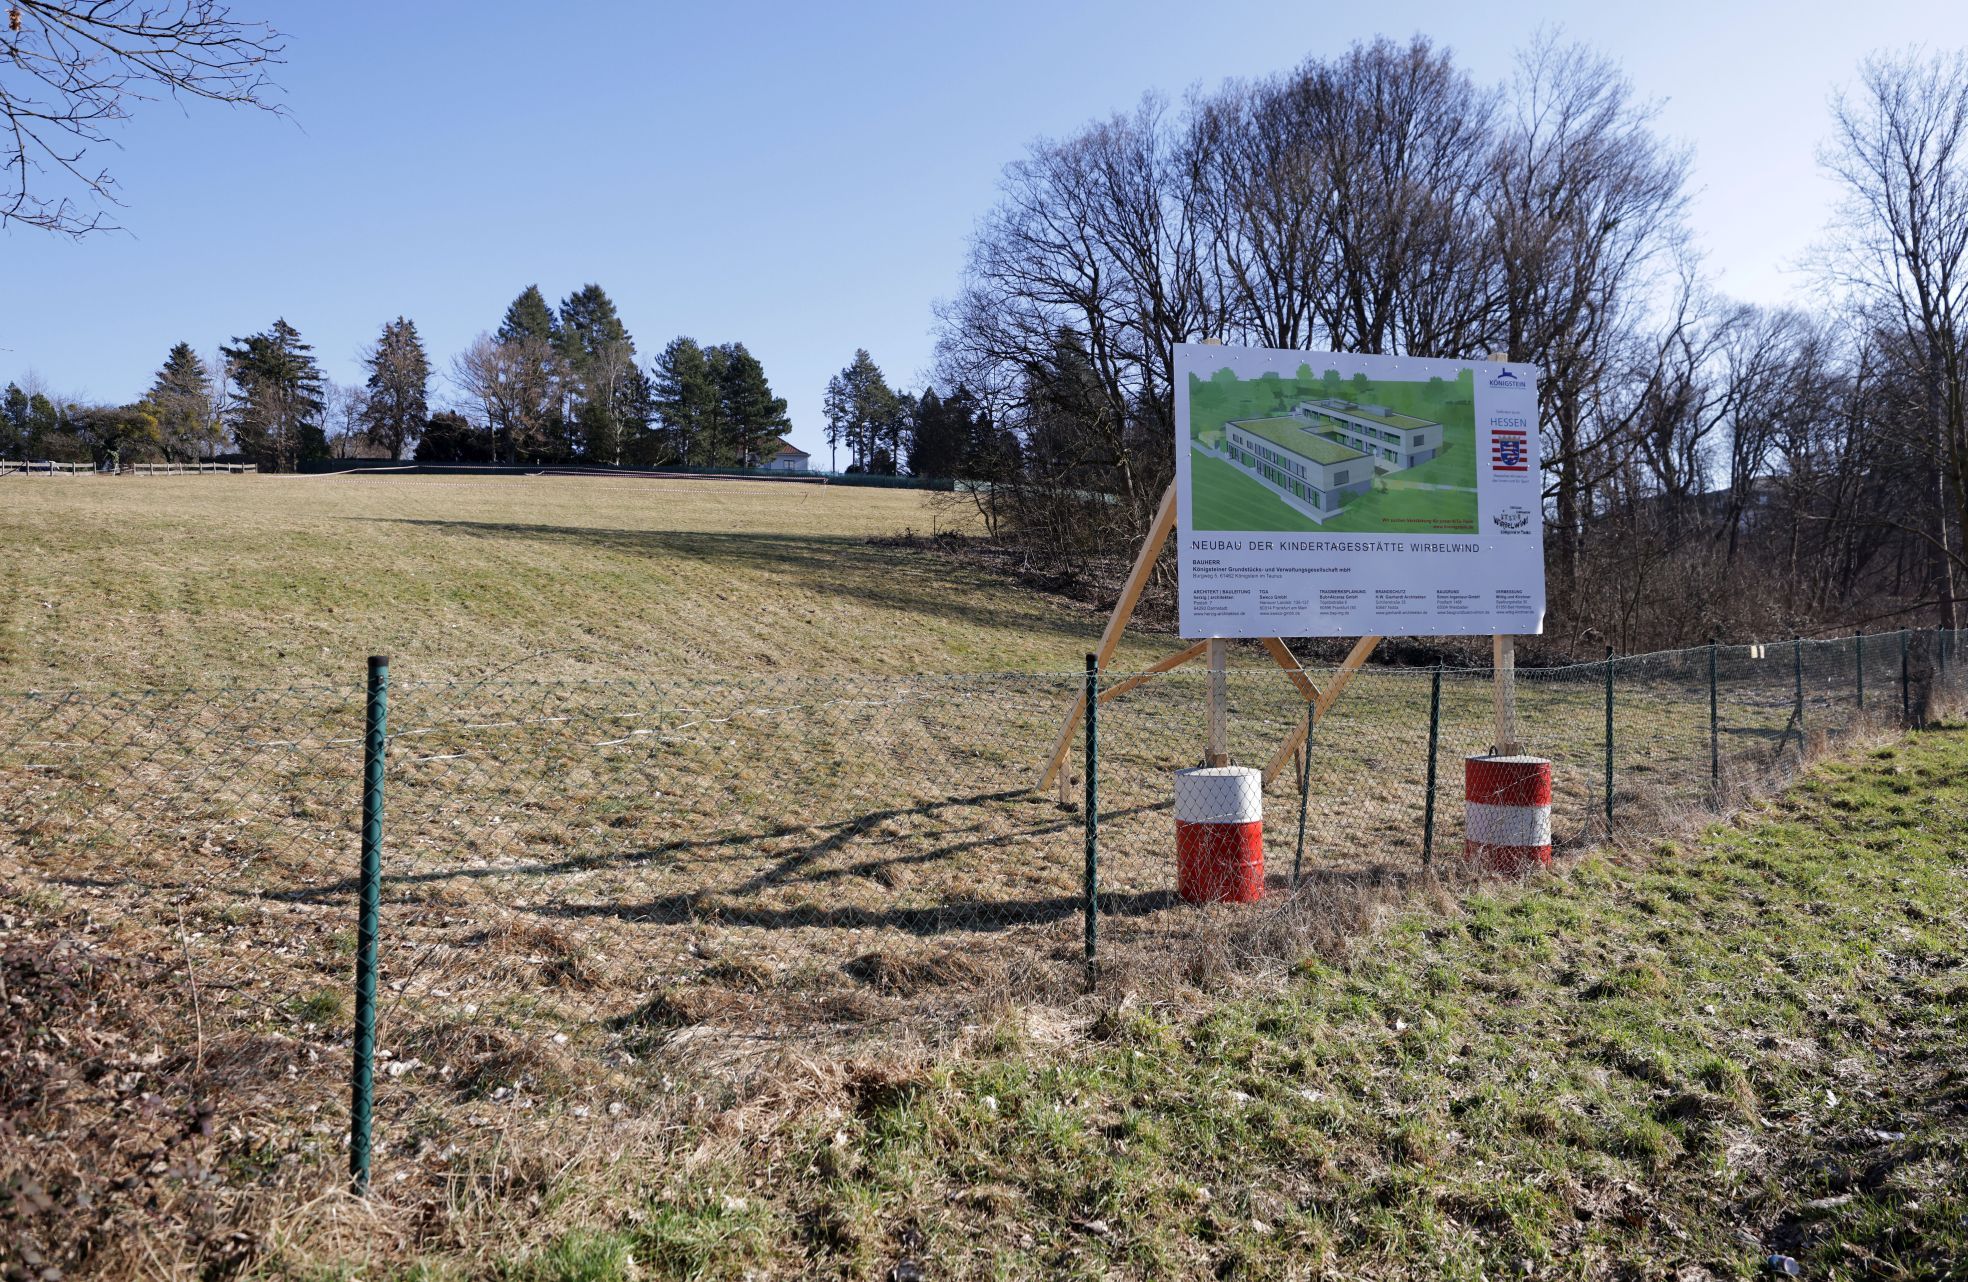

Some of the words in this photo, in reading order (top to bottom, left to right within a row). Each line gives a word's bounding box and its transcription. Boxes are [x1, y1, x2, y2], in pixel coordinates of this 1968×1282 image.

[1489, 379, 1526, 387] KÖNIGSTEIN
[1490, 418, 1527, 427] HESSEN
[1192, 540, 1242, 550] NEUBAU
[1249, 541, 1273, 551] DER
[1280, 541, 1404, 552] KINDERTAGESSTÄTTE
[1411, 543, 1480, 553] WIRBELWIND
